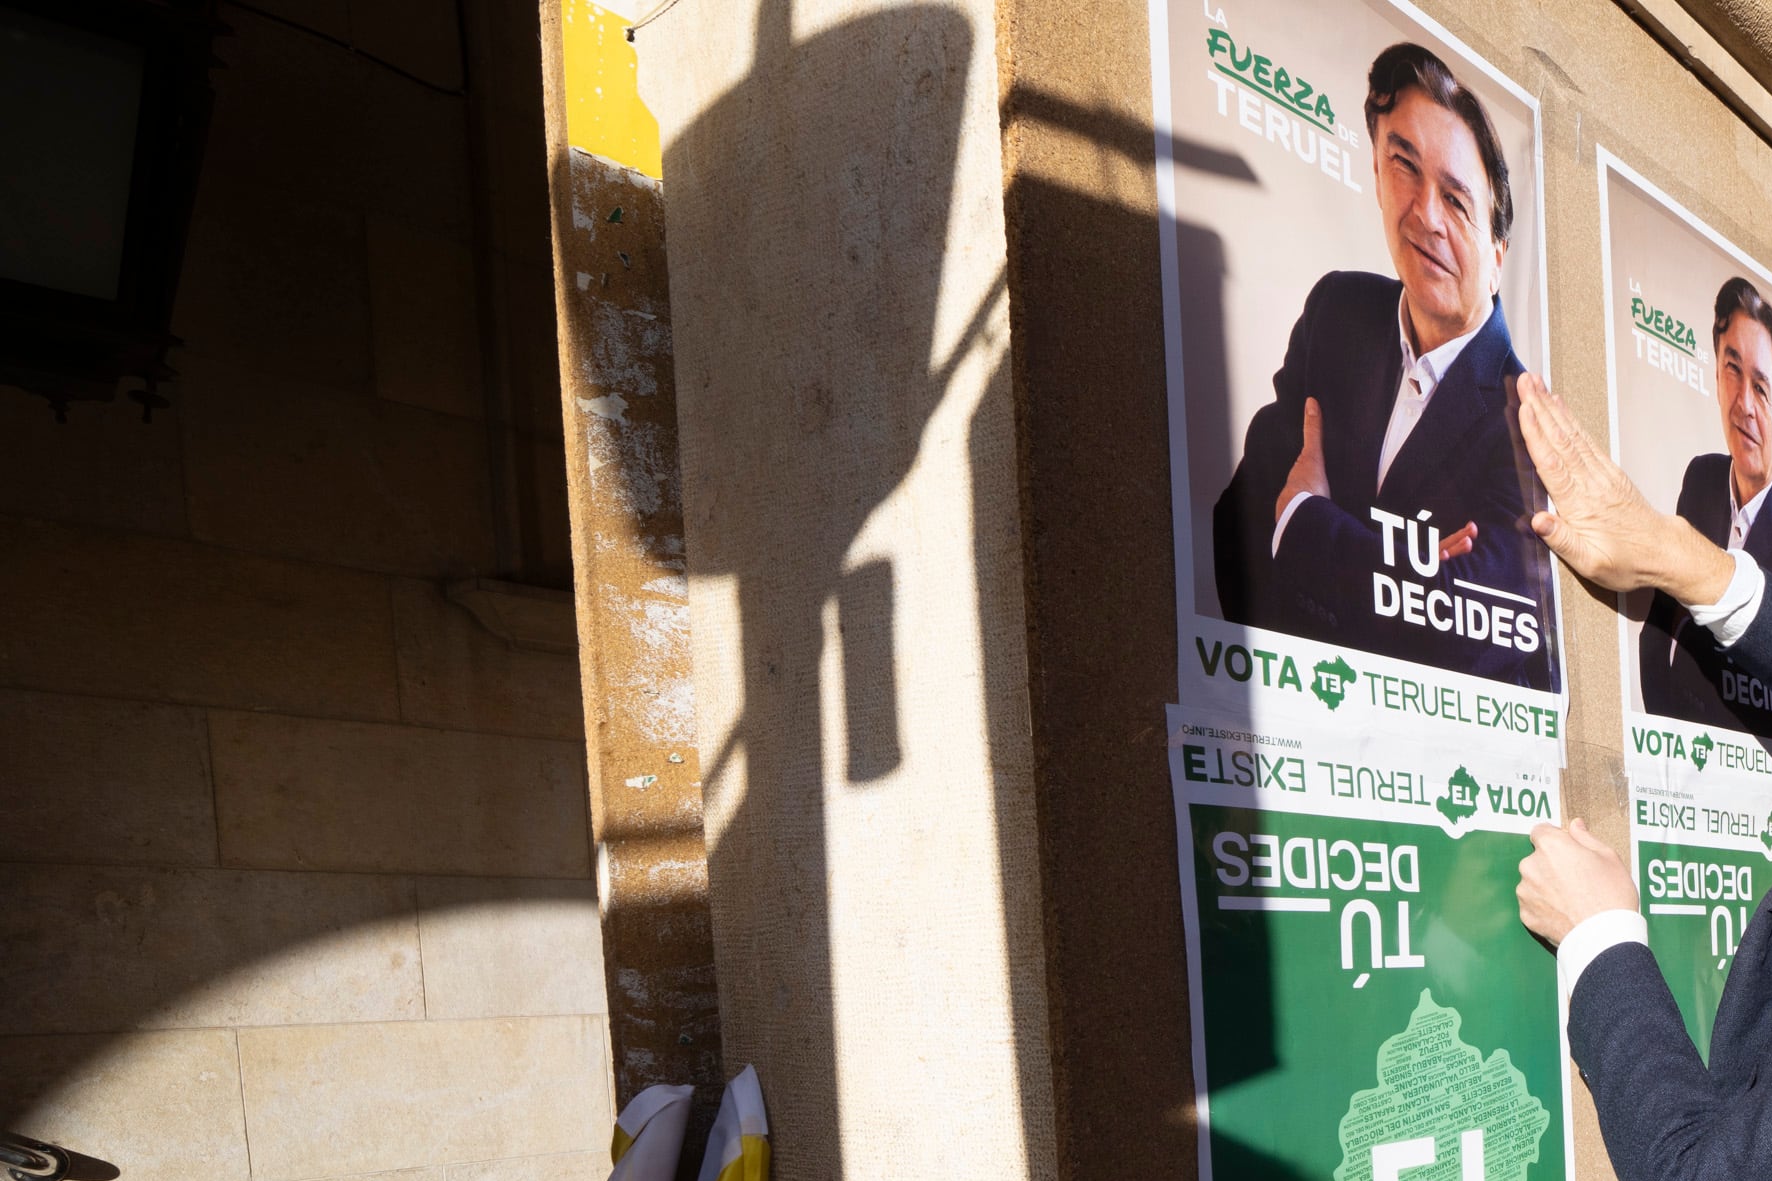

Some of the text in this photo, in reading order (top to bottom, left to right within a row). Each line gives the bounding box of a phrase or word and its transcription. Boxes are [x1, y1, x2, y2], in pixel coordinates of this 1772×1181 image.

[1203, 0, 1228, 28] LA
[1206, 28, 1360, 148] FUERZA DE
[1207, 70, 1362, 193] TERUEL
[1629, 277, 1642, 296] LA
[1631, 297, 1709, 364] FUERZA DE
[1631, 327, 1709, 397] TERUEL
[1370, 506, 1440, 578] TÚ
[1372, 571, 1540, 653] DECIDES
[1195, 636, 1558, 739] VOTA TE TERUEL EXISTE
[1632, 726, 1686, 760] VOTA
[1716, 741, 1772, 775] TERUEL
[1182, 744, 1307, 793] EXISTE
[1317, 761, 1431, 806] TERUEL
[1487, 784, 1552, 819] VOTA
[1636, 799, 1696, 831] EXISTE
[1702, 808, 1758, 838] TERUEL
[1212, 831, 1420, 892] DECIDES
[1648, 859, 1752, 901] DECIDES
[1340, 899, 1425, 988] TÚ
[1417, 1020, 1453, 1035] CALACEITE
[1419, 1039, 1452, 1056] ALLEPUZ
[1412, 1055, 1442, 1072] ABABUJ
[1446, 1055, 1475, 1070] BLANCAS
[1459, 1062, 1480, 1075] BELLO
[1394, 1074, 1428, 1091] ALCAINE
[1402, 1073, 1458, 1100] VALJUNQUERA
[1445, 1075, 1482, 1094] ABEJUELA
[1493, 1076, 1512, 1089] BEZAS
[1398, 1094, 1430, 1113] ALCAÑIZ
[1462, 1085, 1491, 1102] BECEITE
[1402, 1107, 1433, 1125] MARTÍN
[1435, 1101, 1450, 1114] SAN
[1449, 1102, 1482, 1120] CALANDA
[1473, 1103, 1508, 1123] FRESNEDA
[1386, 1120, 1400, 1131] DEL
[1487, 1116, 1516, 1134] SARRIÓN
[1505, 1124, 1531, 1139] ALACÓN
[1345, 1134, 1369, 1148] CUBLA
[1418, 1158, 1456, 1178] CAMINREAL
